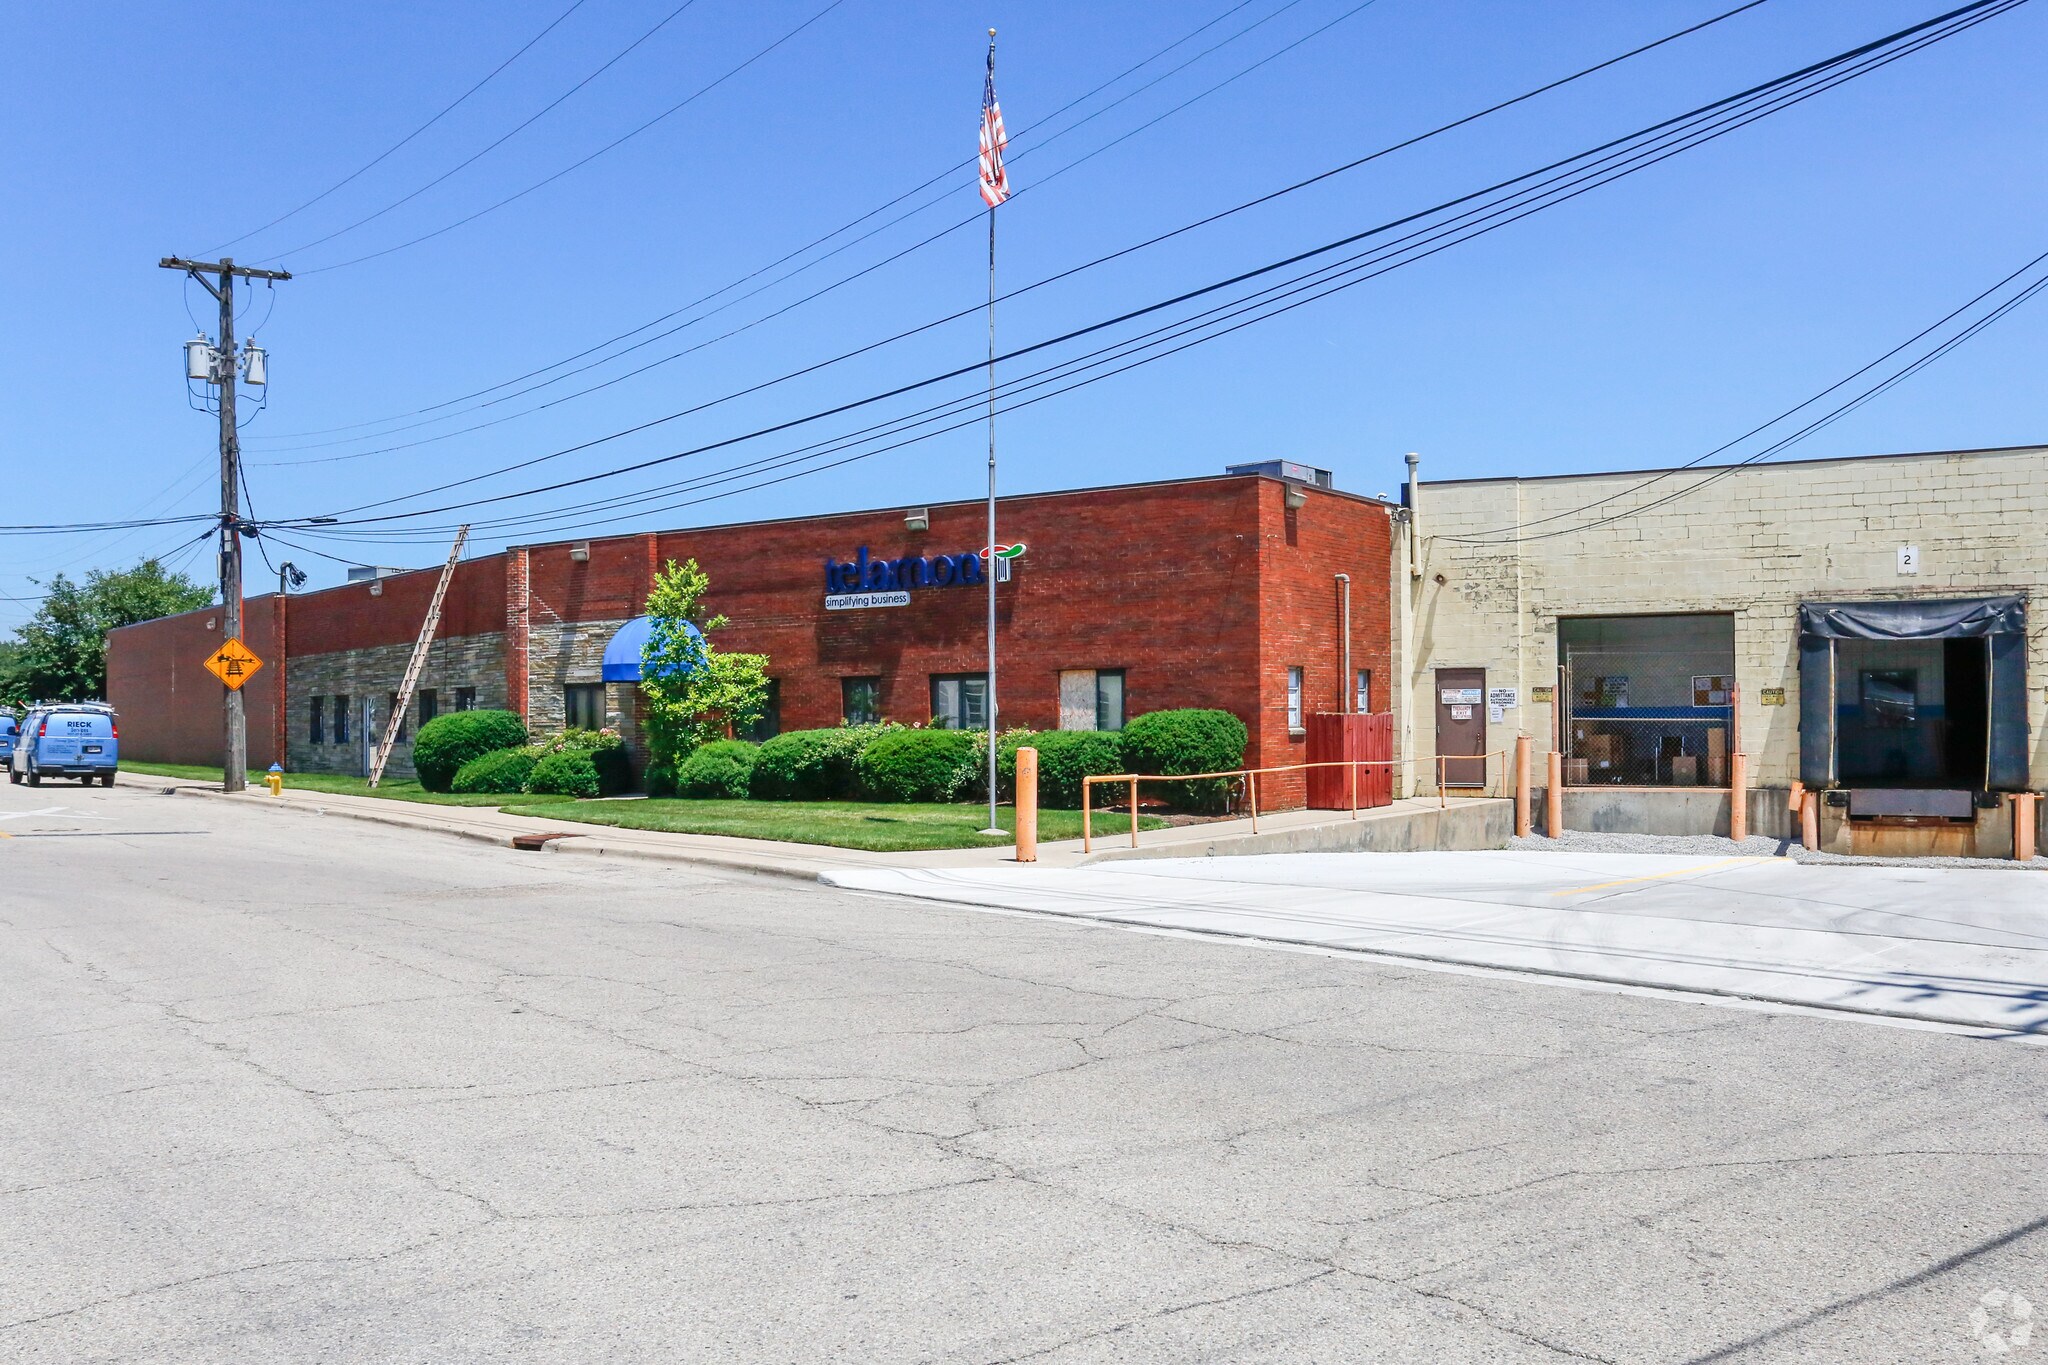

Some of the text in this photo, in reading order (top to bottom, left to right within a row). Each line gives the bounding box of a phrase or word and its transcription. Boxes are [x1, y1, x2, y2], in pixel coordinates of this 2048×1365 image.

[1903, 554, 1911, 565] 2
[825, 545, 985, 593] telamon
[826, 594, 907, 608] simplifying business
